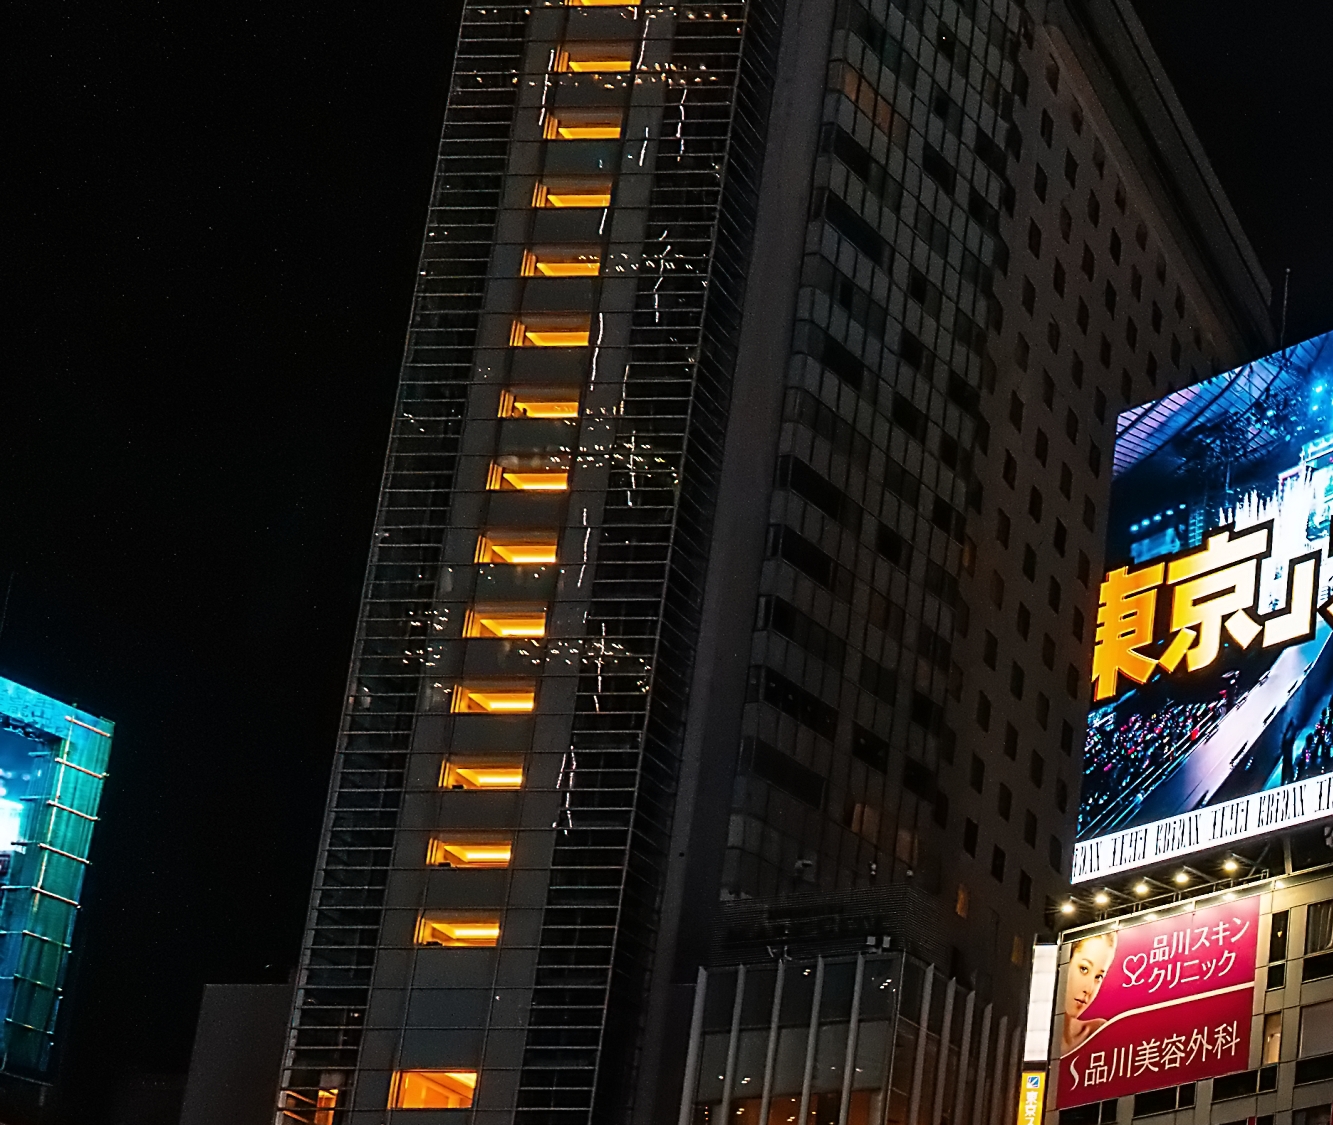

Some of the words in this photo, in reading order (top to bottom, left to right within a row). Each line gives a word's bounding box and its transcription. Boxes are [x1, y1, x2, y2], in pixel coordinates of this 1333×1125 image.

[1149, 917, 1250, 964] 品川スキン
[1148, 950, 1237, 993] クリニック
[1084, 1020, 1241, 1088] 品川美容外科
